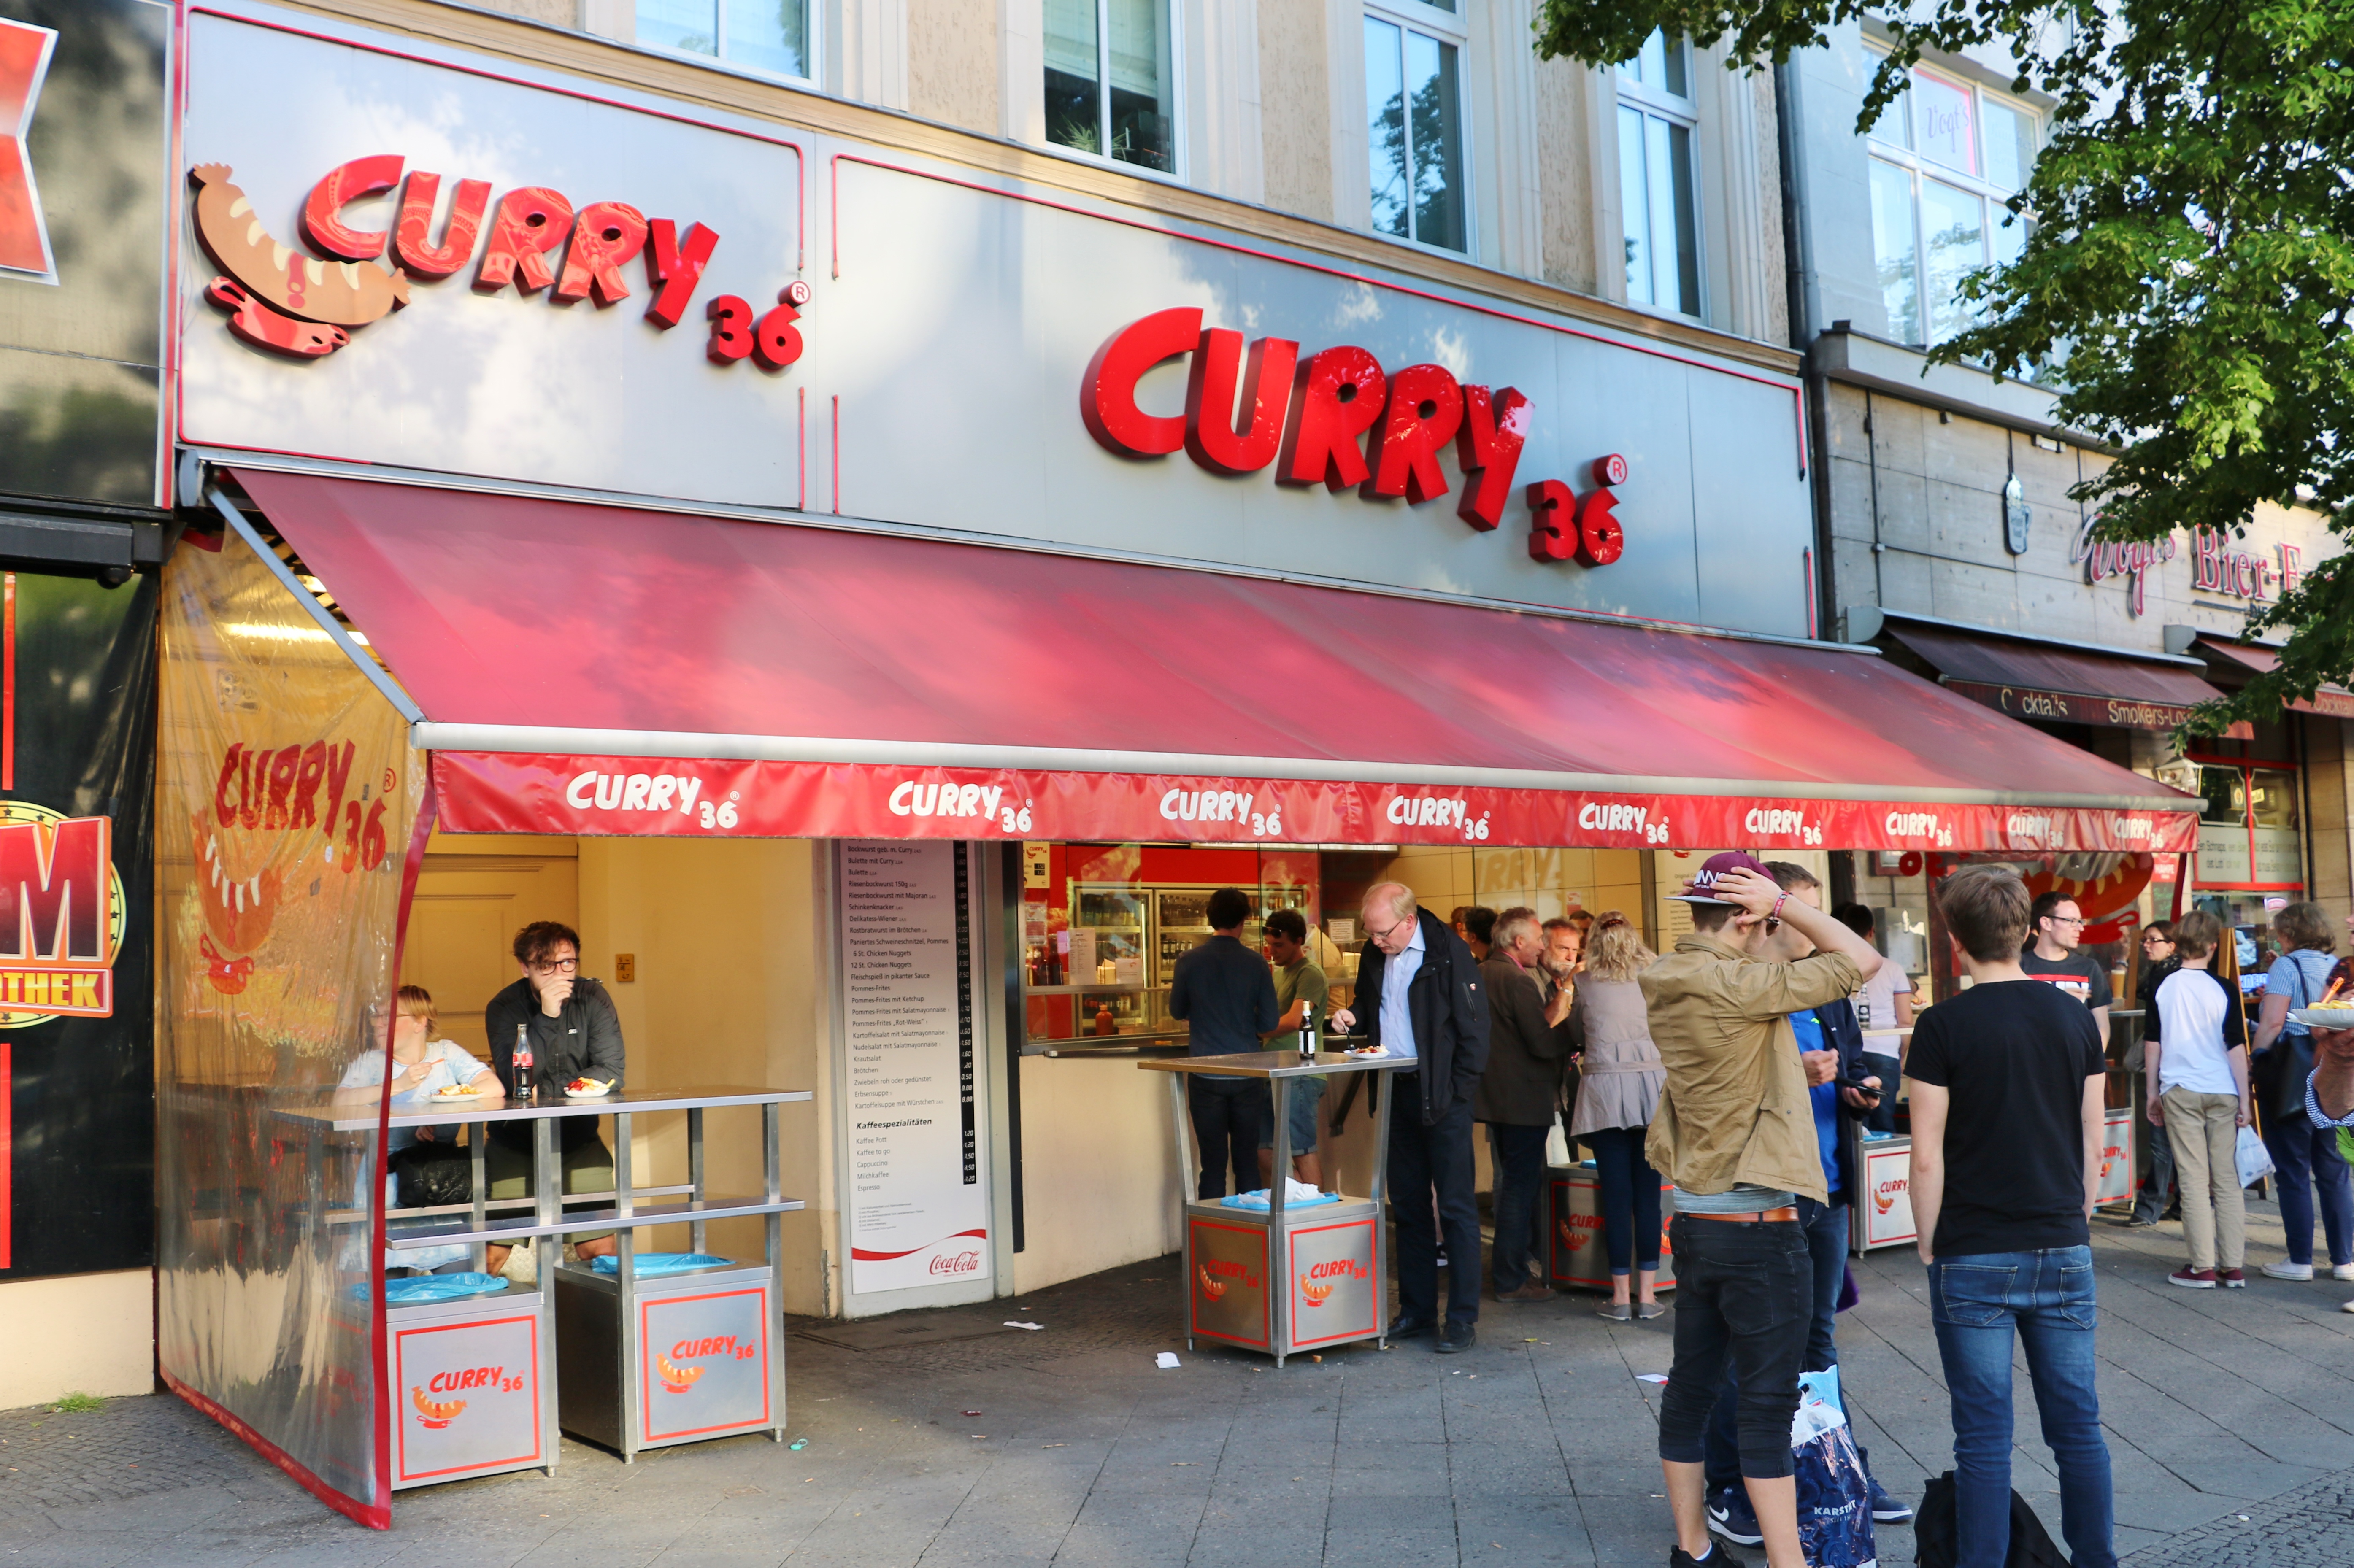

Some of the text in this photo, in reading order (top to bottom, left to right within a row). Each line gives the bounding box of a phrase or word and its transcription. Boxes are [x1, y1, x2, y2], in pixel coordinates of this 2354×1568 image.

[297, 154, 719, 330] CURRY
[707, 294, 803, 370] 36
[1081, 306, 1535, 532] CURRY
[1526, 478, 1623, 568] 36
[2108, 700, 2187, 726] Smokers-Lo
[216, 738, 355, 839] CURRY
[341, 797, 387, 873] 36
[566, 770, 737, 829] CURRY 36
[889, 780, 1032, 833] CURRY 36
[1160, 788, 1282, 836] CURRY 36
[1386, 795, 1489, 840] CURRY 36
[1578, 802, 1669, 844] CURRY 36
[1745, 808, 1822, 845] CURRY 36
[1886, 811, 1952, 847] CURRY 36
[2007, 815, 2064, 847] CURRY 36
[2114, 817, 2164, 849] CURRY 36
[898, 846, 912, 854] Curry
[0, 972, 100, 1008] THEK
[903, 1007, 946, 1015] Salatmayonnaise
[893, 1042, 937, 1050] Salatmayonnaise
[901, 1029, 944, 1038] Salatmayonnaise
[905, 1076, 932, 1084] gedünstet
[855, 1102, 895, 1110] Kartoffelsuppe
[857, 1118, 932, 1130] Kaffeespezialitäten
[857, 1160, 888, 1169] Cappuccino
[858, 1184, 880, 1192] Espresso
[1881, 1179, 1908, 1193] CURRY
[930, 1250, 980, 1275] Coca-Cola
[1208, 1259, 1258, 1288] CURRY 36
[1311, 1259, 1367, 1279] CURRY 36
[671, 1335, 755, 1360] CURRY 36
[429, 1366, 524, 1393] CURRY 36
